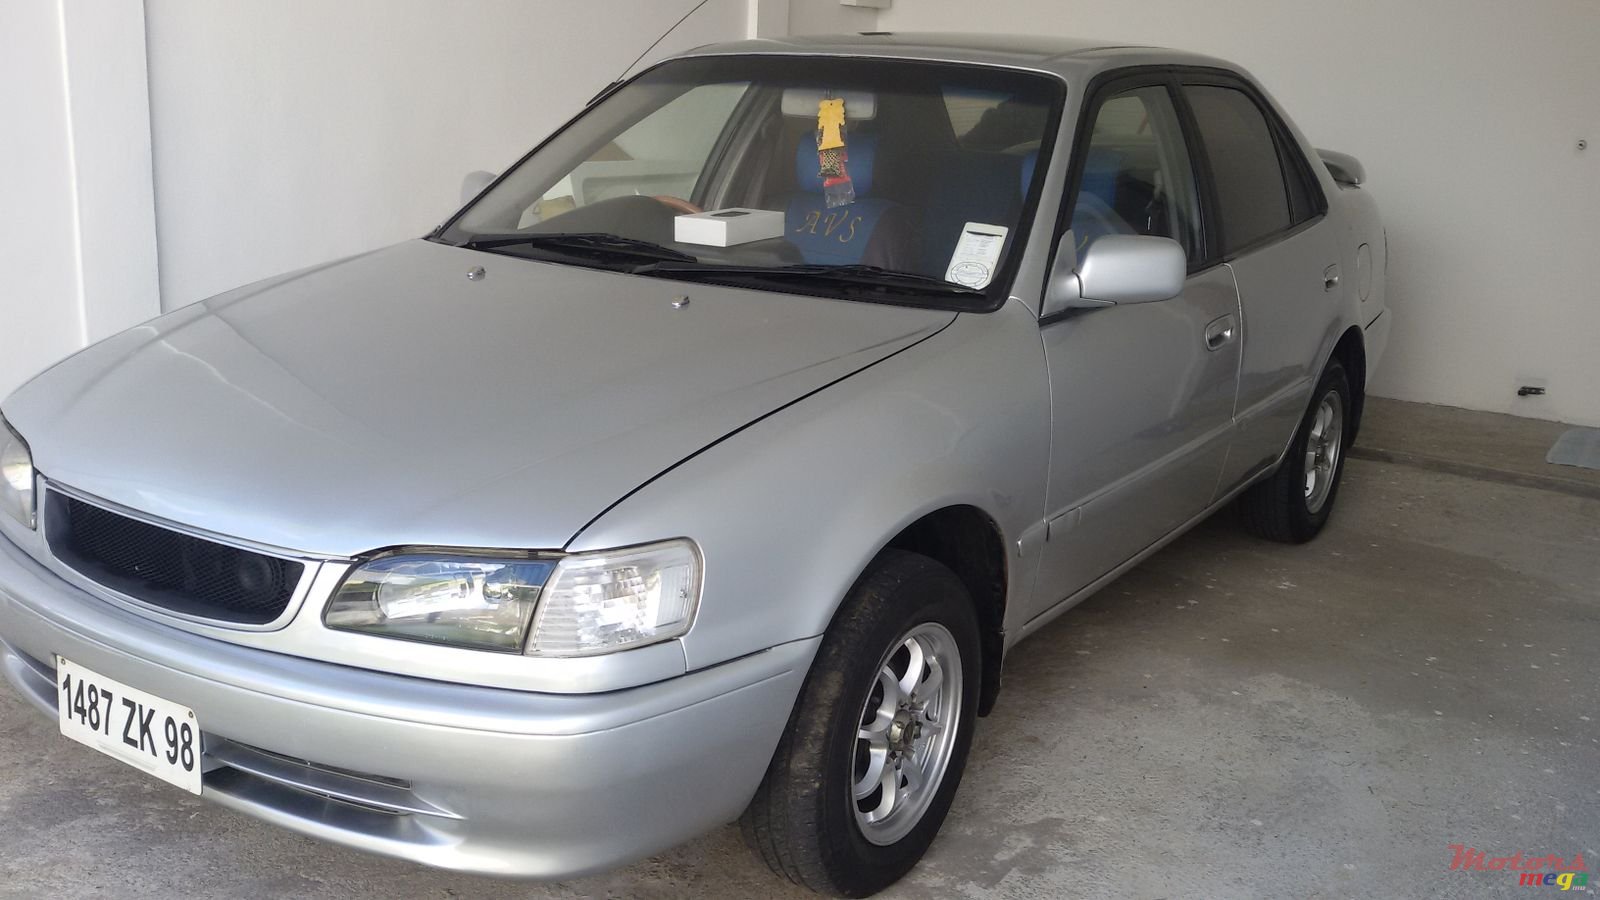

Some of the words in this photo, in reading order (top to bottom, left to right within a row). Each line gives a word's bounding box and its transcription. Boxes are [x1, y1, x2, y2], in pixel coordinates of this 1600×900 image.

[796, 210, 862, 243] AVS
[63, 673, 113, 736] 1487
[122, 697, 157, 757] ZK
[165, 716, 194, 772] 98
